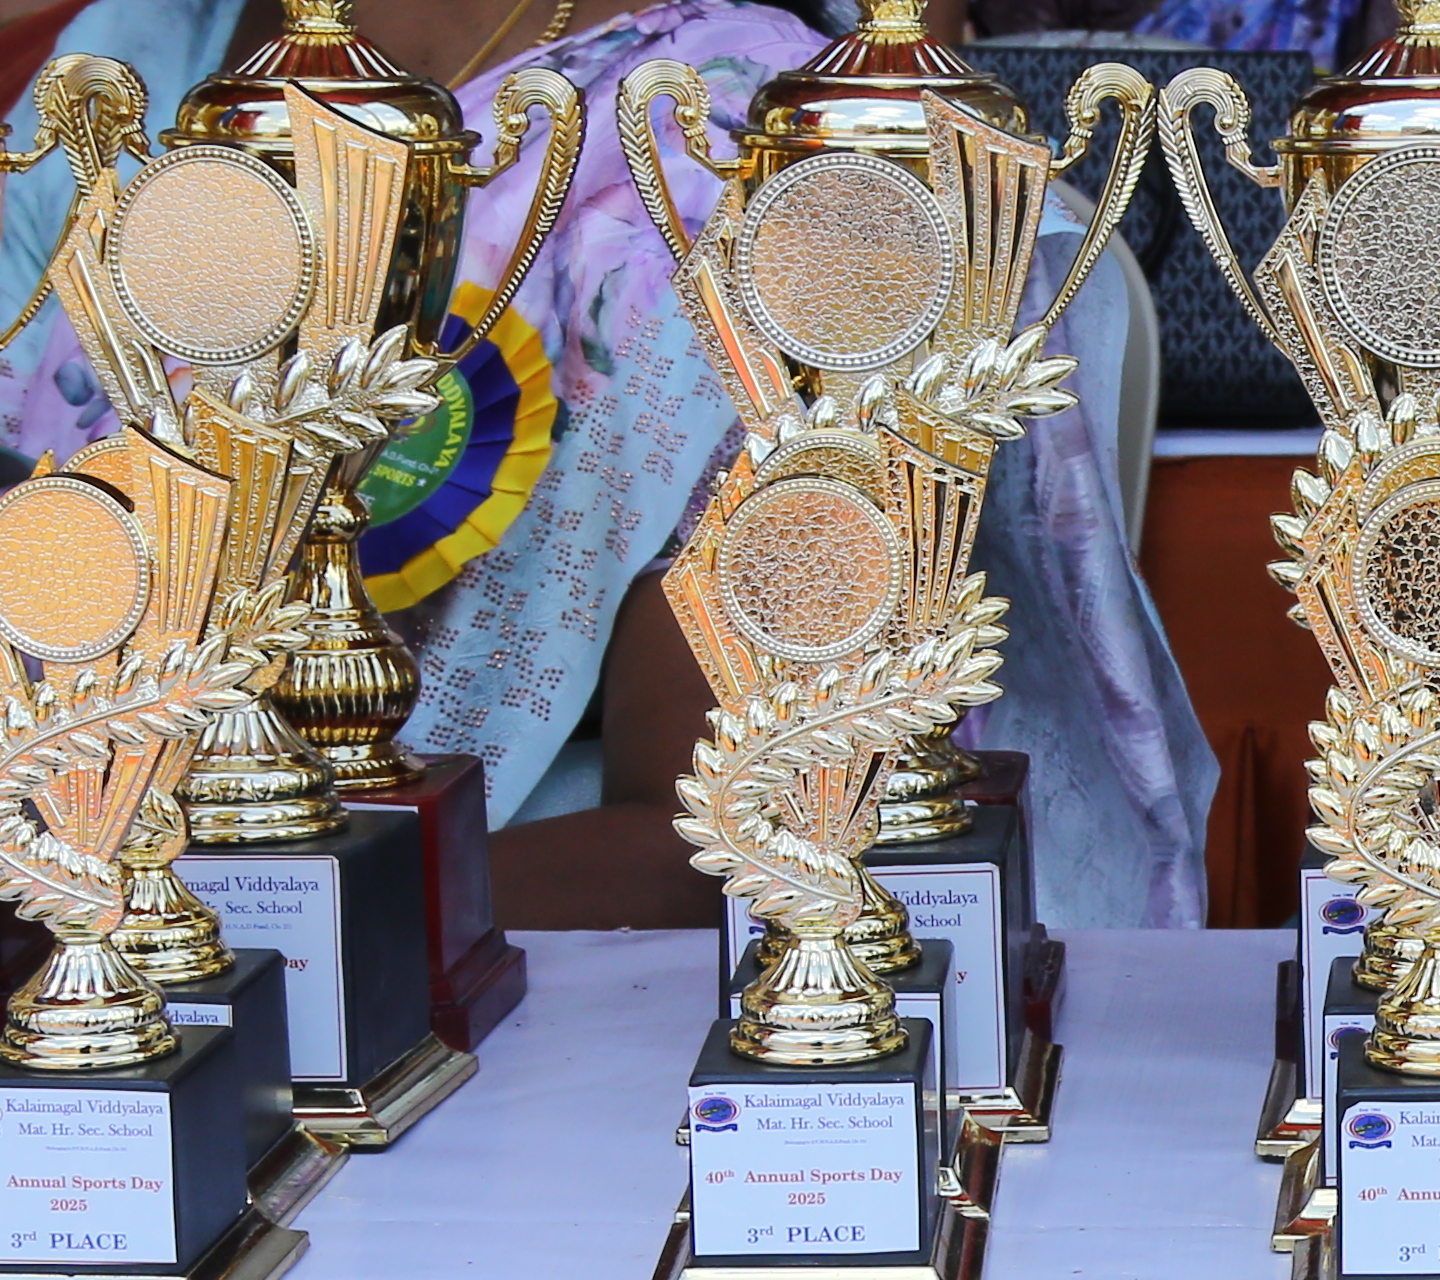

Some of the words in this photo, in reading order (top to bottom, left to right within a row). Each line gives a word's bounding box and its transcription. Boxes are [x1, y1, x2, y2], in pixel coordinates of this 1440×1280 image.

[234, 876, 319, 894] Viddyalaya
[226, 901, 252, 914] Sec.
[257, 901, 302, 913] School
[915, 914, 961, 927] School
[6, 1099, 82, 1116] Kalaimagal
[86, 1100, 164, 1117] Viddyalaya
[744, 1093, 822, 1109] Kalaimagal
[826, 1092, 904, 1109] Viddyalaya
[18, 1122, 47, 1135] Mat.
[52, 1123, 74, 1135] Hr.
[78, 1123, 104, 1136] Sec.
[108, 1124, 153, 1137] School
[757, 1118, 786, 1130] Mat.
[791, 1117, 813, 1129] Hr.
[817, 1117, 844, 1129] Sec.
[848, 1115, 893, 1128] School
[1412, 1135, 1440, 1147] Mat.
[7, 1175, 66, 1188] Annual
[72, 1176, 126, 1192] Sports
[131, 1176, 163, 1193] Day
[705, 1170, 734, 1183] 40th
[744, 1170, 805, 1183] Annual
[811, 1169, 865, 1185] Sports
[870, 1168, 902, 1183] Day
[788, 1192, 825, 1205] 2025
[1358, 1187, 1387, 1201] 40th
[50, 1199, 87, 1211] 2025
[11, 1231, 37, 1248] 3rd
[50, 1233, 127, 1250] PLACE
[747, 1226, 773, 1243] 3rd
[788, 1226, 865, 1242] PLACE
[1399, 1244, 1425, 1262] 3rd
